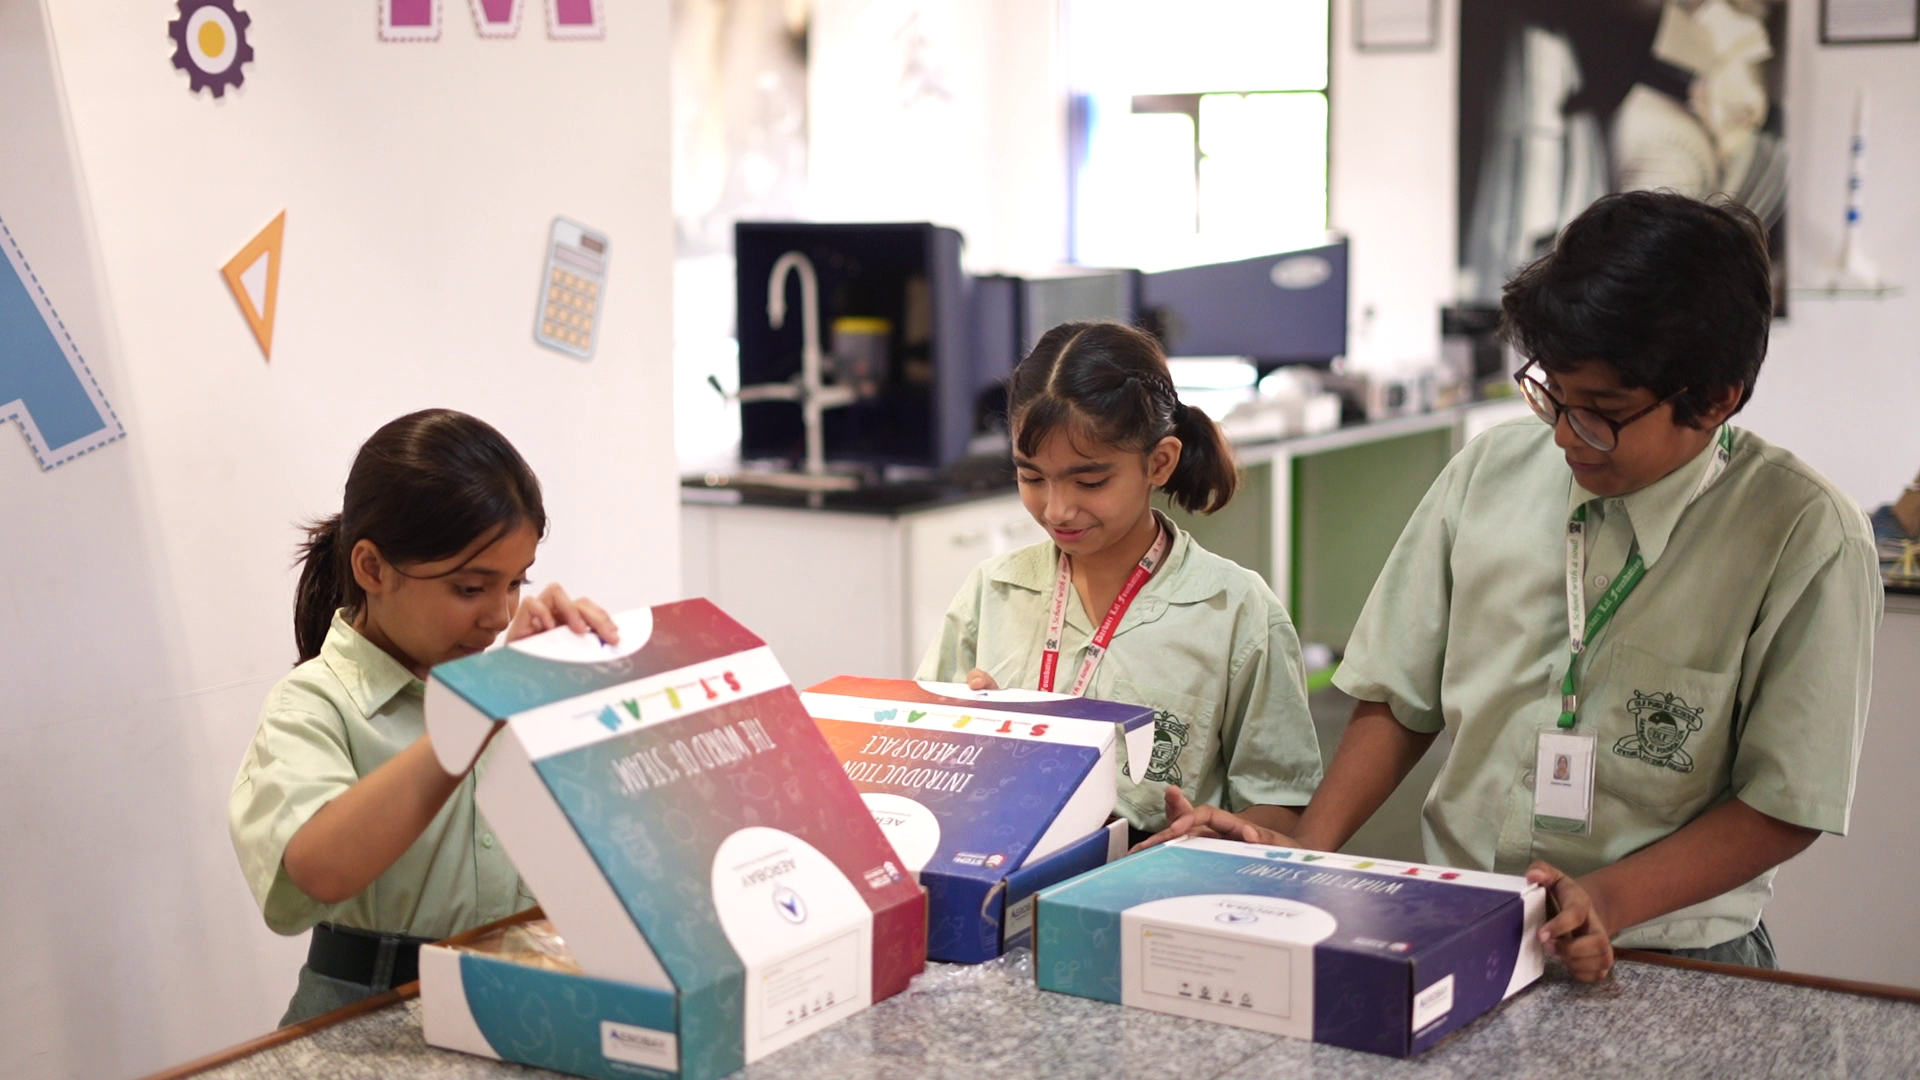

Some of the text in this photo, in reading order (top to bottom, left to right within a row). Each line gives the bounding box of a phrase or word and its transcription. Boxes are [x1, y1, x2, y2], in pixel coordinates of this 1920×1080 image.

[1052, 600, 1063, 626] School
[1058, 579, 1067, 598] with
[691, 724, 752, 769] WORLD
[738, 717, 777, 754] THE
[860, 735, 984, 765] TO AEROSPACE
[669, 740, 700, 777] OF
[841, 760, 975, 793] INTRODUCTION
[741, 858, 797, 888] AEROBAY
[1341, 875, 1404, 895] WHAT
